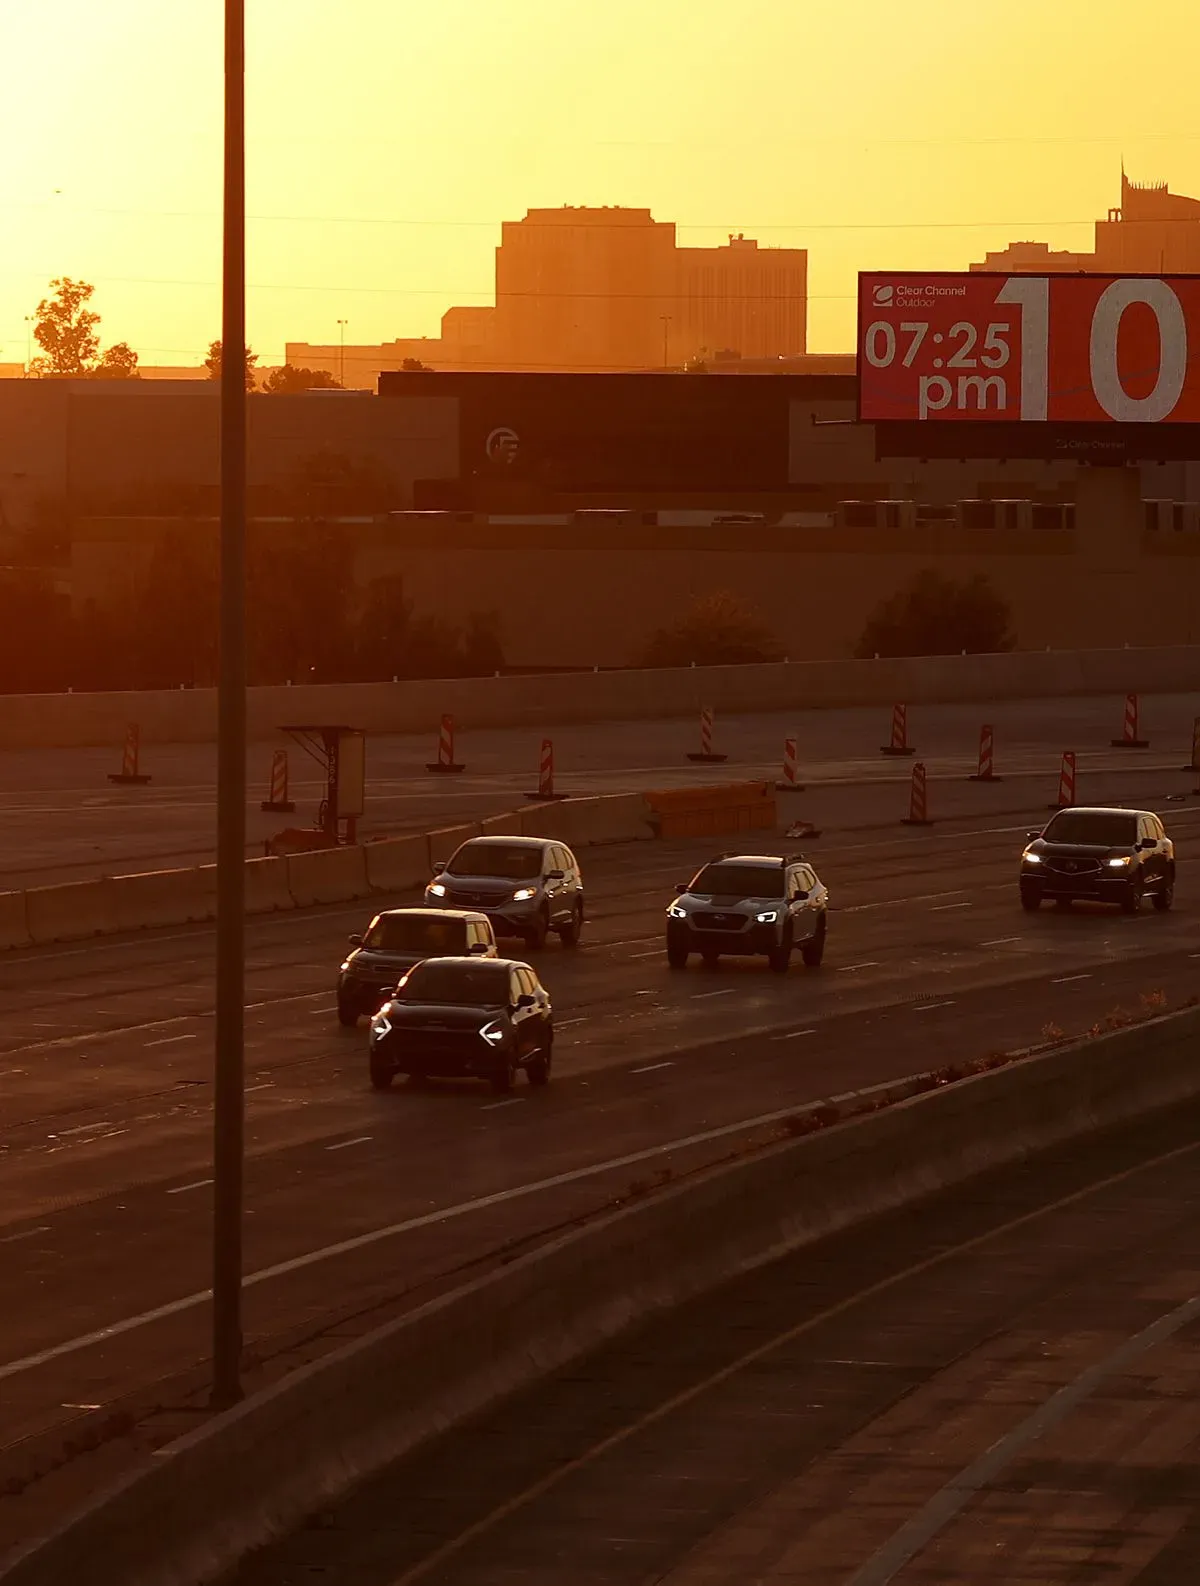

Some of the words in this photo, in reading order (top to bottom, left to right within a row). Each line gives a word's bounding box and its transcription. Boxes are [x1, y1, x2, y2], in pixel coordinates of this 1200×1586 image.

[896, 285, 923, 296] Clear
[924, 285, 966, 296] Channel
[896, 297, 936, 307] Outdoor
[865, 320, 1010, 369] 07:25
[918, 374, 1007, 421] pm
